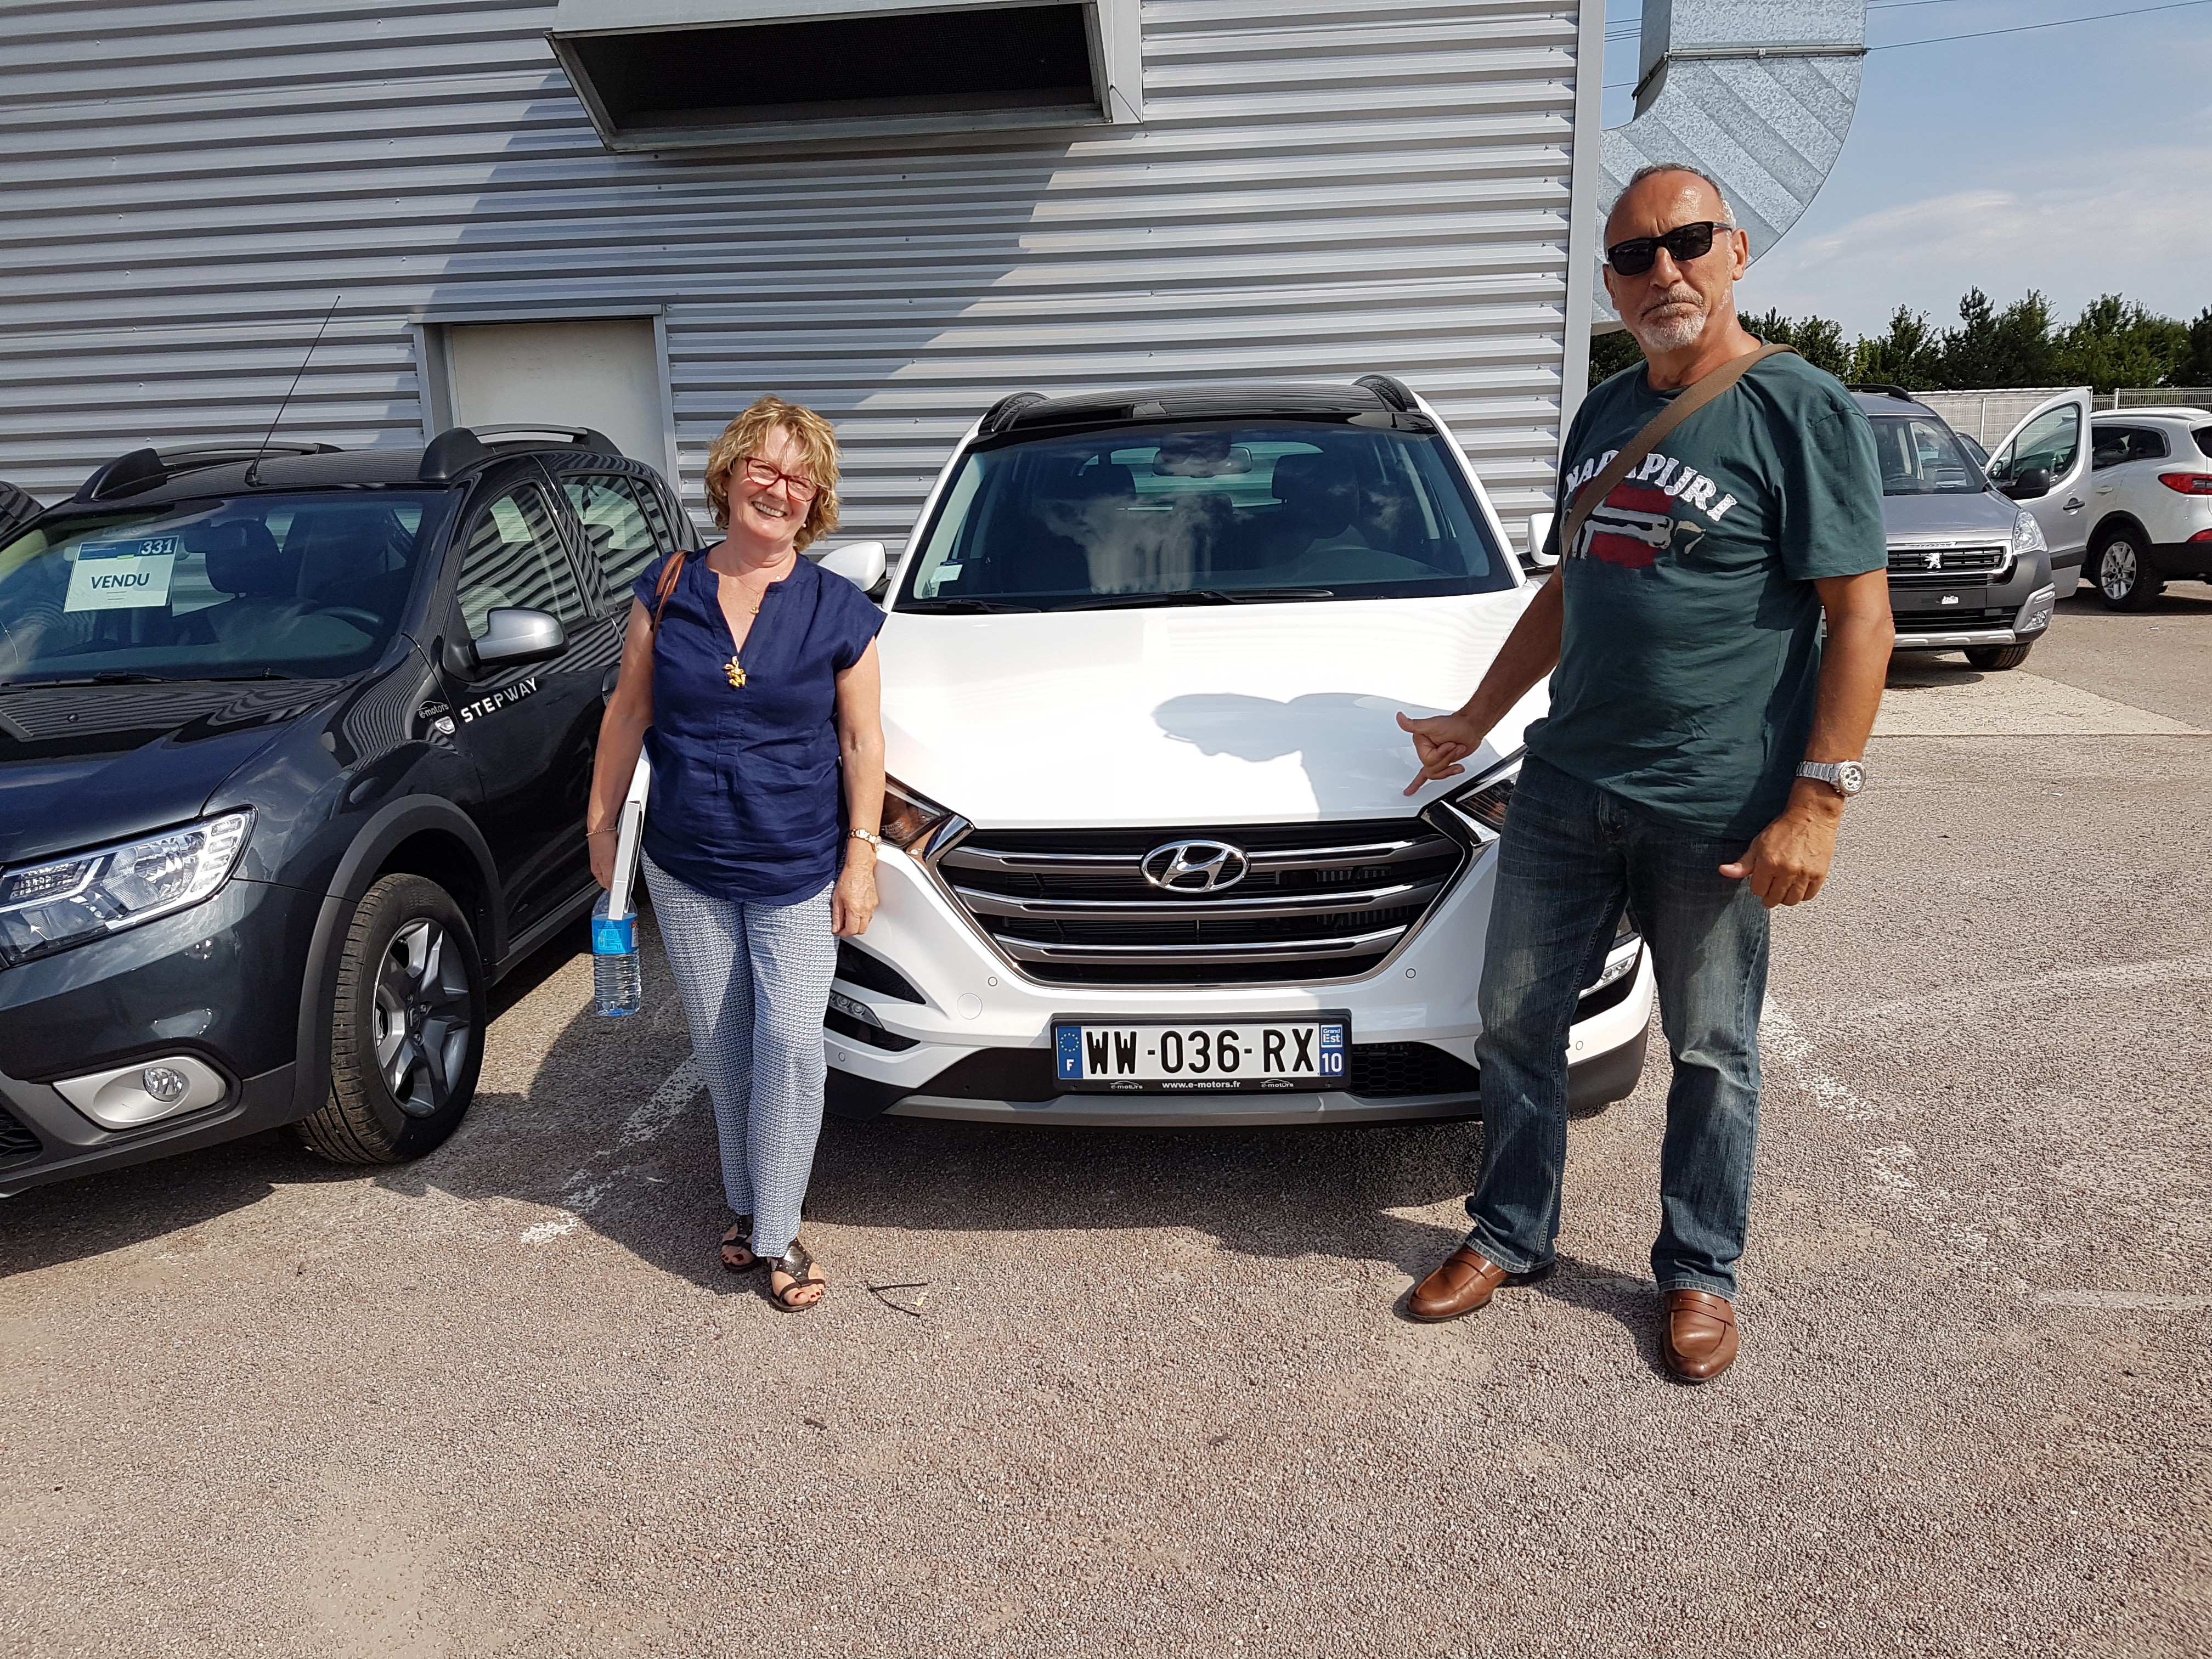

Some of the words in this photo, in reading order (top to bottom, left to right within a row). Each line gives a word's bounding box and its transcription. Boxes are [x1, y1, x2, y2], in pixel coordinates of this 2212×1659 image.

[1564, 449, 1738, 522] NAPPIJRI
[141, 539, 173, 555] 331
[91, 573, 150, 589] VENDU
[460, 677, 538, 723] STEPWAY
[1323, 1034, 1341, 1043] Est
[1086, 1028, 1314, 1074] WW-036-RX
[1066, 1059, 1074, 1071] F
[1322, 1052, 1342, 1073] 10
